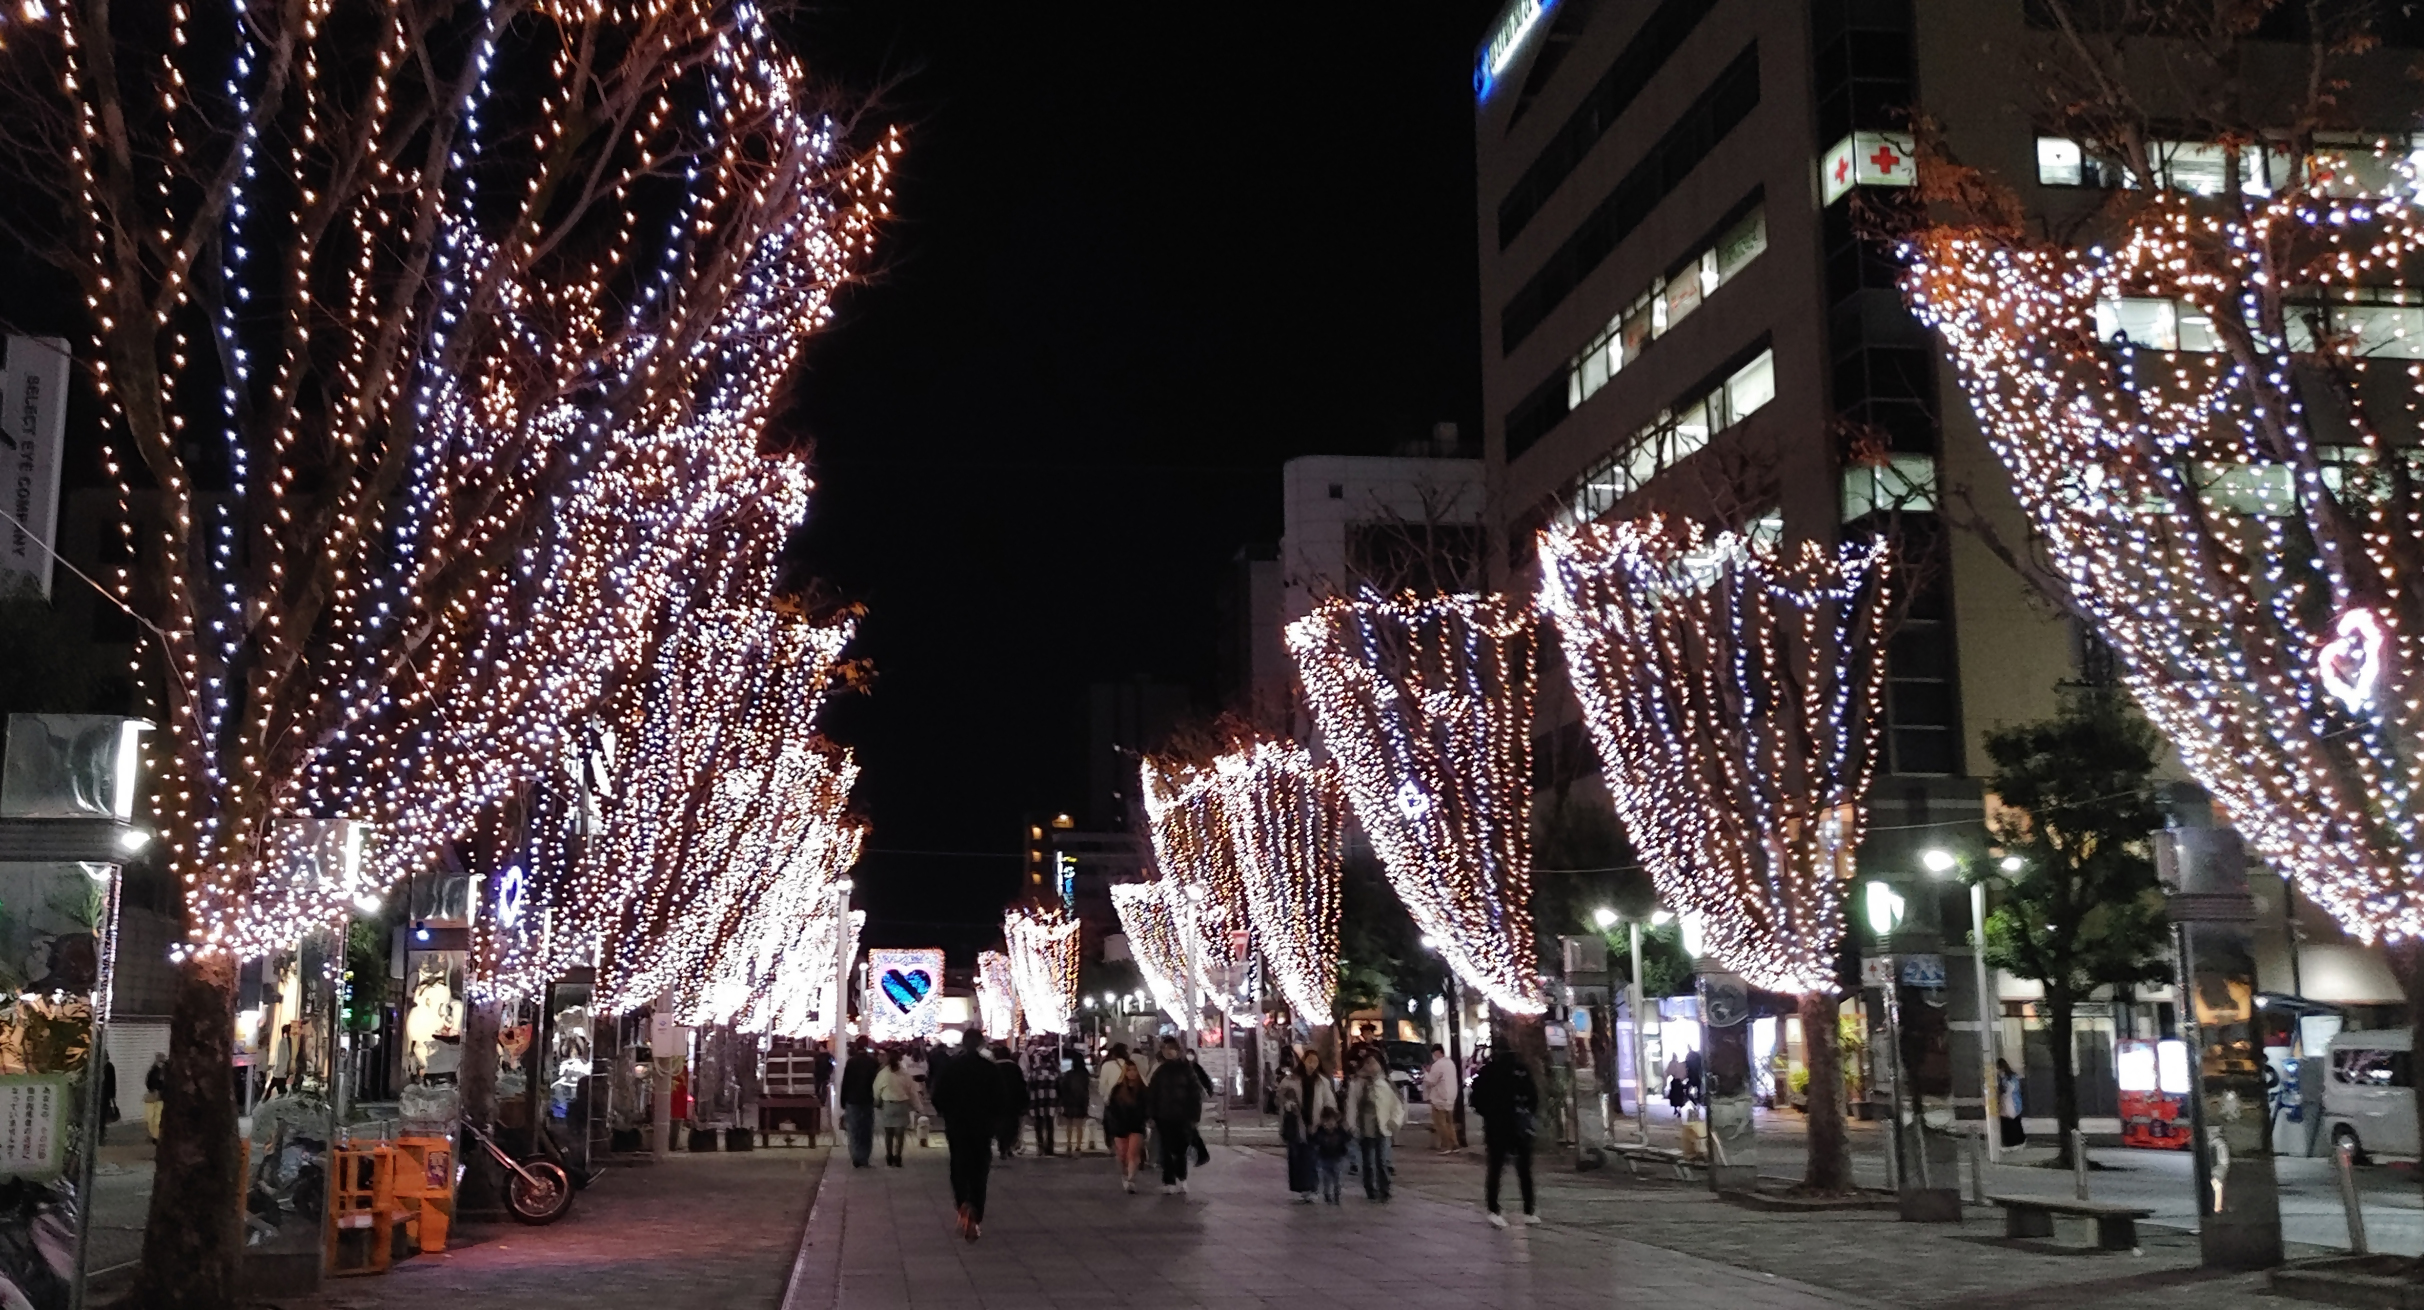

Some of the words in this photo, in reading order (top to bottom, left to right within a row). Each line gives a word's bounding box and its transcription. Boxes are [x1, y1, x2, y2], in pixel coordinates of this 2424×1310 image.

[22, 374, 40, 436] SELECT
[19, 440, 35, 472] EYE
[12, 476, 31, 557] COMPANY
